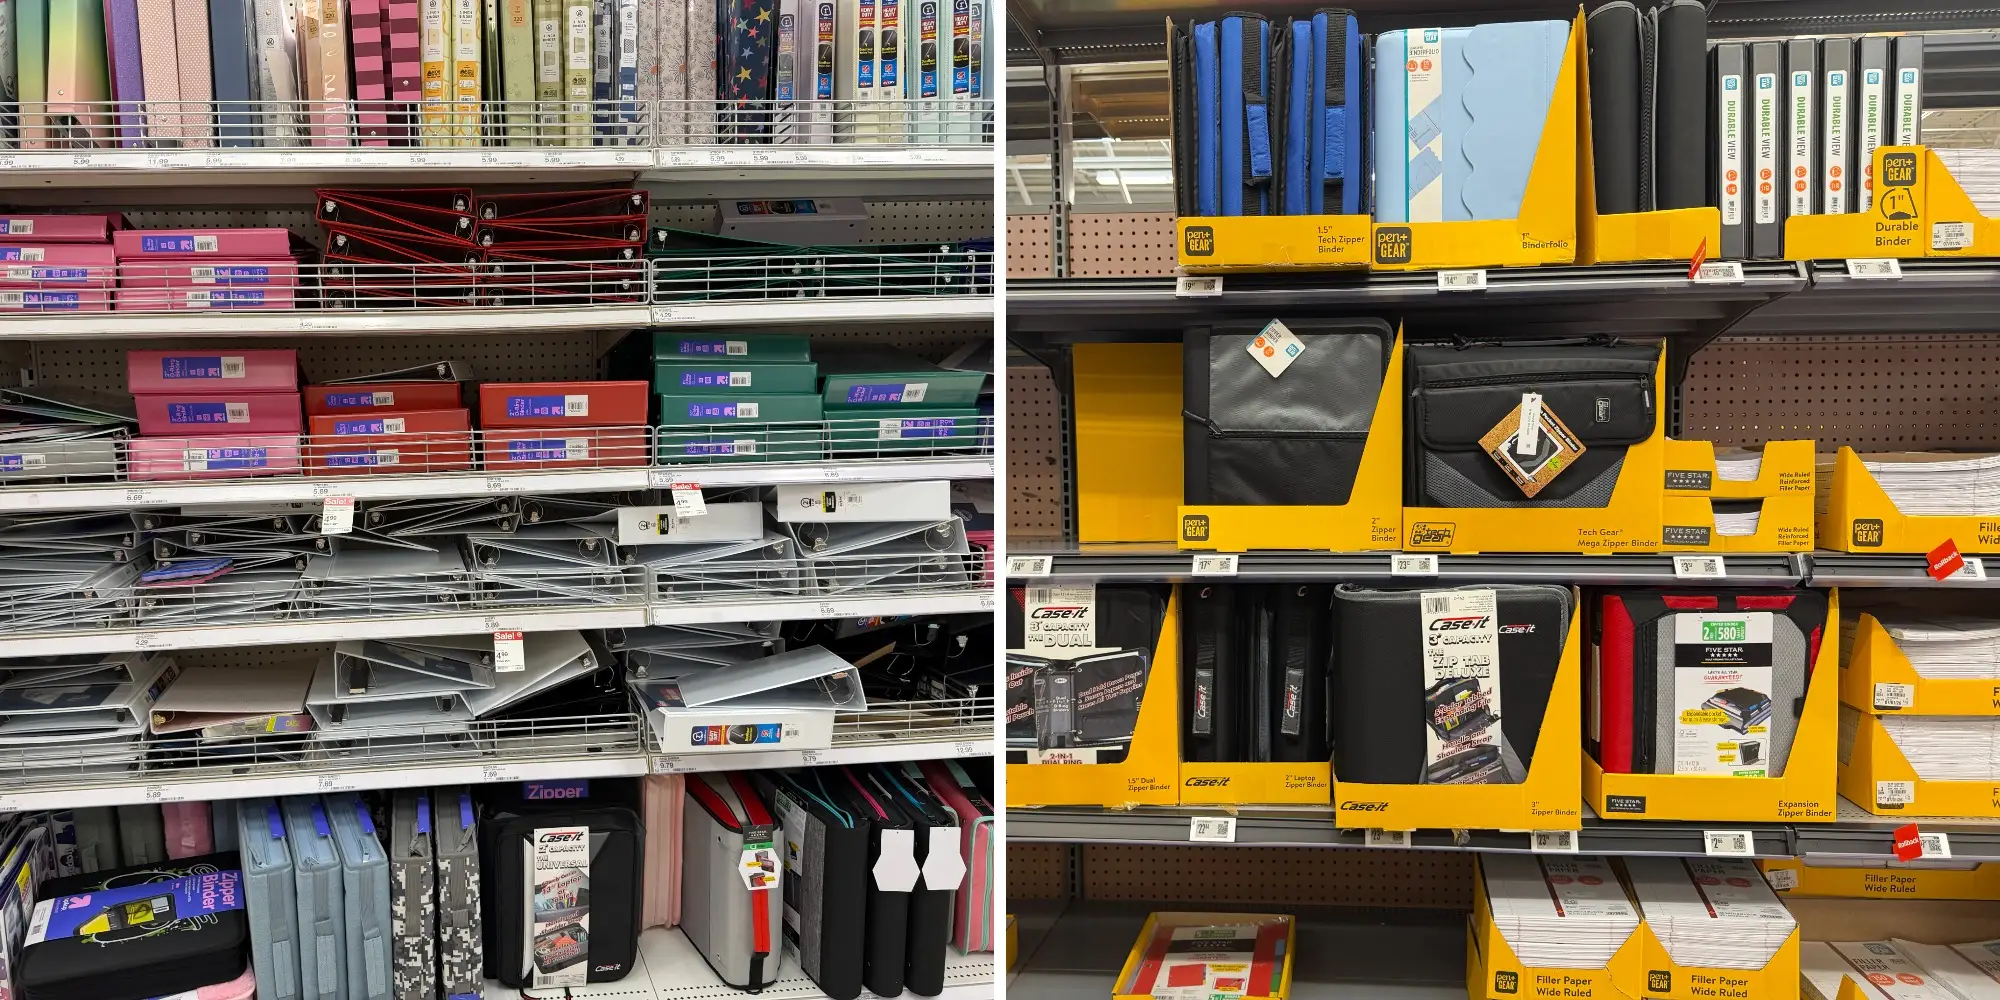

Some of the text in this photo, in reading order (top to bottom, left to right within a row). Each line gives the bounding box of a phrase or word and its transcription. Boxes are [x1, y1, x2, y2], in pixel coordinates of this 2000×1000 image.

[1868, 94, 1877, 132] DURABLE
[1903, 93, 1912, 132] DURABLE
[1727, 100, 1736, 160] DURABLE VIEW
[1761, 99, 1770, 159] DURABLE VIEW
[1796, 96, 1806, 156] DURABLE VIEW
[1831, 95, 1841, 156] DURABLE VIEW
[1885, 156, 1914, 174] pen+
[1888, 169, 1913, 181] GEAR
[1889, 195, 1905, 210] 1"
[1317, 225, 1333, 234] 1.5"
[1875, 220, 1919, 232] Durable
[1318, 234, 1365, 246] Tech Zipper
[1377, 231, 1408, 247] pen+
[1522, 240, 1569, 250] Binderfolio
[1875, 235, 1912, 246] Binder
[1189, 239, 1211, 252] GEAR
[1318, 245, 1345, 254] Binder
[1380, 242, 1407, 258] GEAR
[325, 497, 348, 505] Sale!
[1186, 526, 1206, 537] GEAR
[1371, 525, 1397, 536] Zipper
[1578, 528, 1597, 536] Tech
[1857, 529, 1879, 543] GEAR
[1371, 534, 1397, 542] Binder
[1577, 539, 1600, 549] Mega
[1602, 539, 1629, 550] Zipper
[1631, 538, 1659, 547] Binder
[1933, 550, 1959, 571] Rollback
[1043, 621, 1090, 632] CAPACITY
[494, 632, 515, 640] Sale!
[1703, 626, 1737, 640] 2 580
[1044, 634, 1093, 648] DUAL
[1443, 634, 1493, 645] CAPACITY
[1433, 655, 1491, 669] ZIP TAB
[1010, 667, 1033, 680] Inside
[1434, 667, 1491, 680] DELUXE
[1008, 678, 1024, 689] Out
[1435, 705, 1478, 726] Expanding
[1441, 727, 1487, 751] Handle and
[1436, 734, 1493, 761] Shoulder Strap
[1141, 776, 1156, 784] Dual
[1285, 781, 1307, 789] Zipper
[1294, 774, 1316, 784] Laptop
[1128, 783, 1171, 792] Zipper Binder
[146, 791, 161, 799] 5.89
[1778, 800, 1820, 809] Expansion
[1531, 808, 1578, 817] Zipper Binder
[1778, 808, 1832, 818] Zipper Binder
[1897, 836, 1920, 849] Rollback
[549, 844, 586, 854] CAPACITY
[536, 859, 588, 870] UNIVERSAL
[1865, 874, 1917, 884] Filler Paper
[202, 873, 219, 910] Binder
[219, 872, 238, 907] Zipper
[1864, 884, 1917, 893] Wide Ruled
[1497, 980, 1516, 991] GEAR
[1536, 975, 1593, 987] Filler Paper
[1651, 979, 1670, 990] GEAR
[1691, 975, 1749, 988] Filler Paper
[1536, 987, 1592, 998] Wide Ruled
[1691, 987, 1748, 998] Wide Ruled
